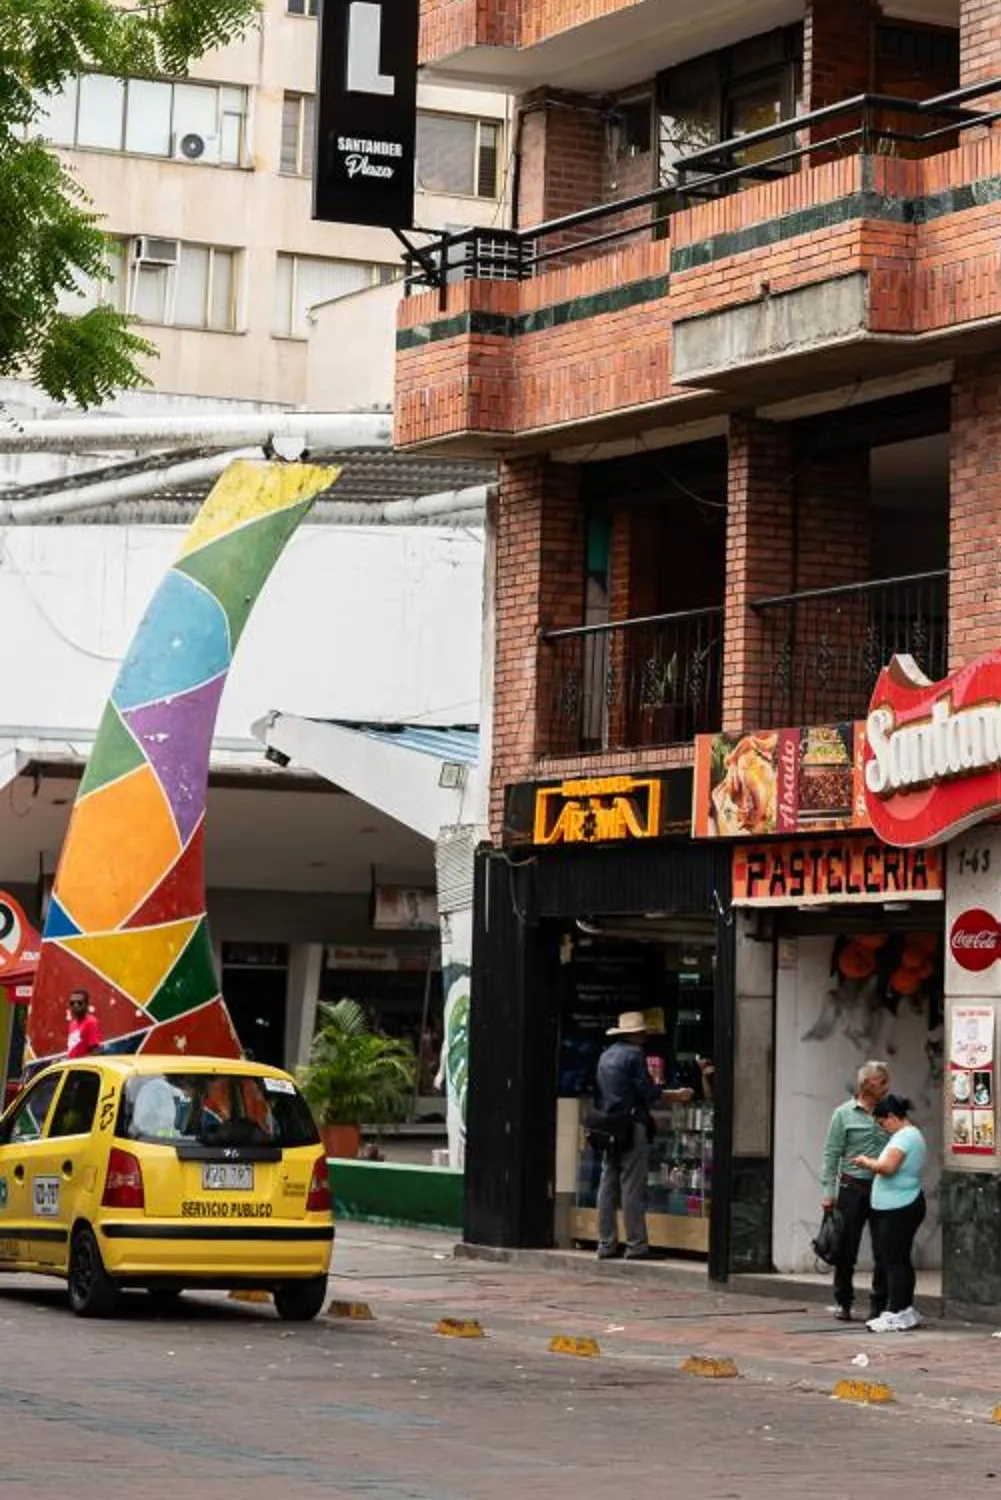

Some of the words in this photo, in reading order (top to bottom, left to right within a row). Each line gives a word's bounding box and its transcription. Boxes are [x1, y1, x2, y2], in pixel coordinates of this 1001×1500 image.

[337, 136, 402, 156] SANTANDER
[345, 153, 394, 178] Plaza
[779, 739, 797, 830] Asado
[746, 846, 928, 899] PASTELERIA
[181, 1202, 229, 1217] SERVICIO
[231, 1203, 273, 1217] PUBLICO
